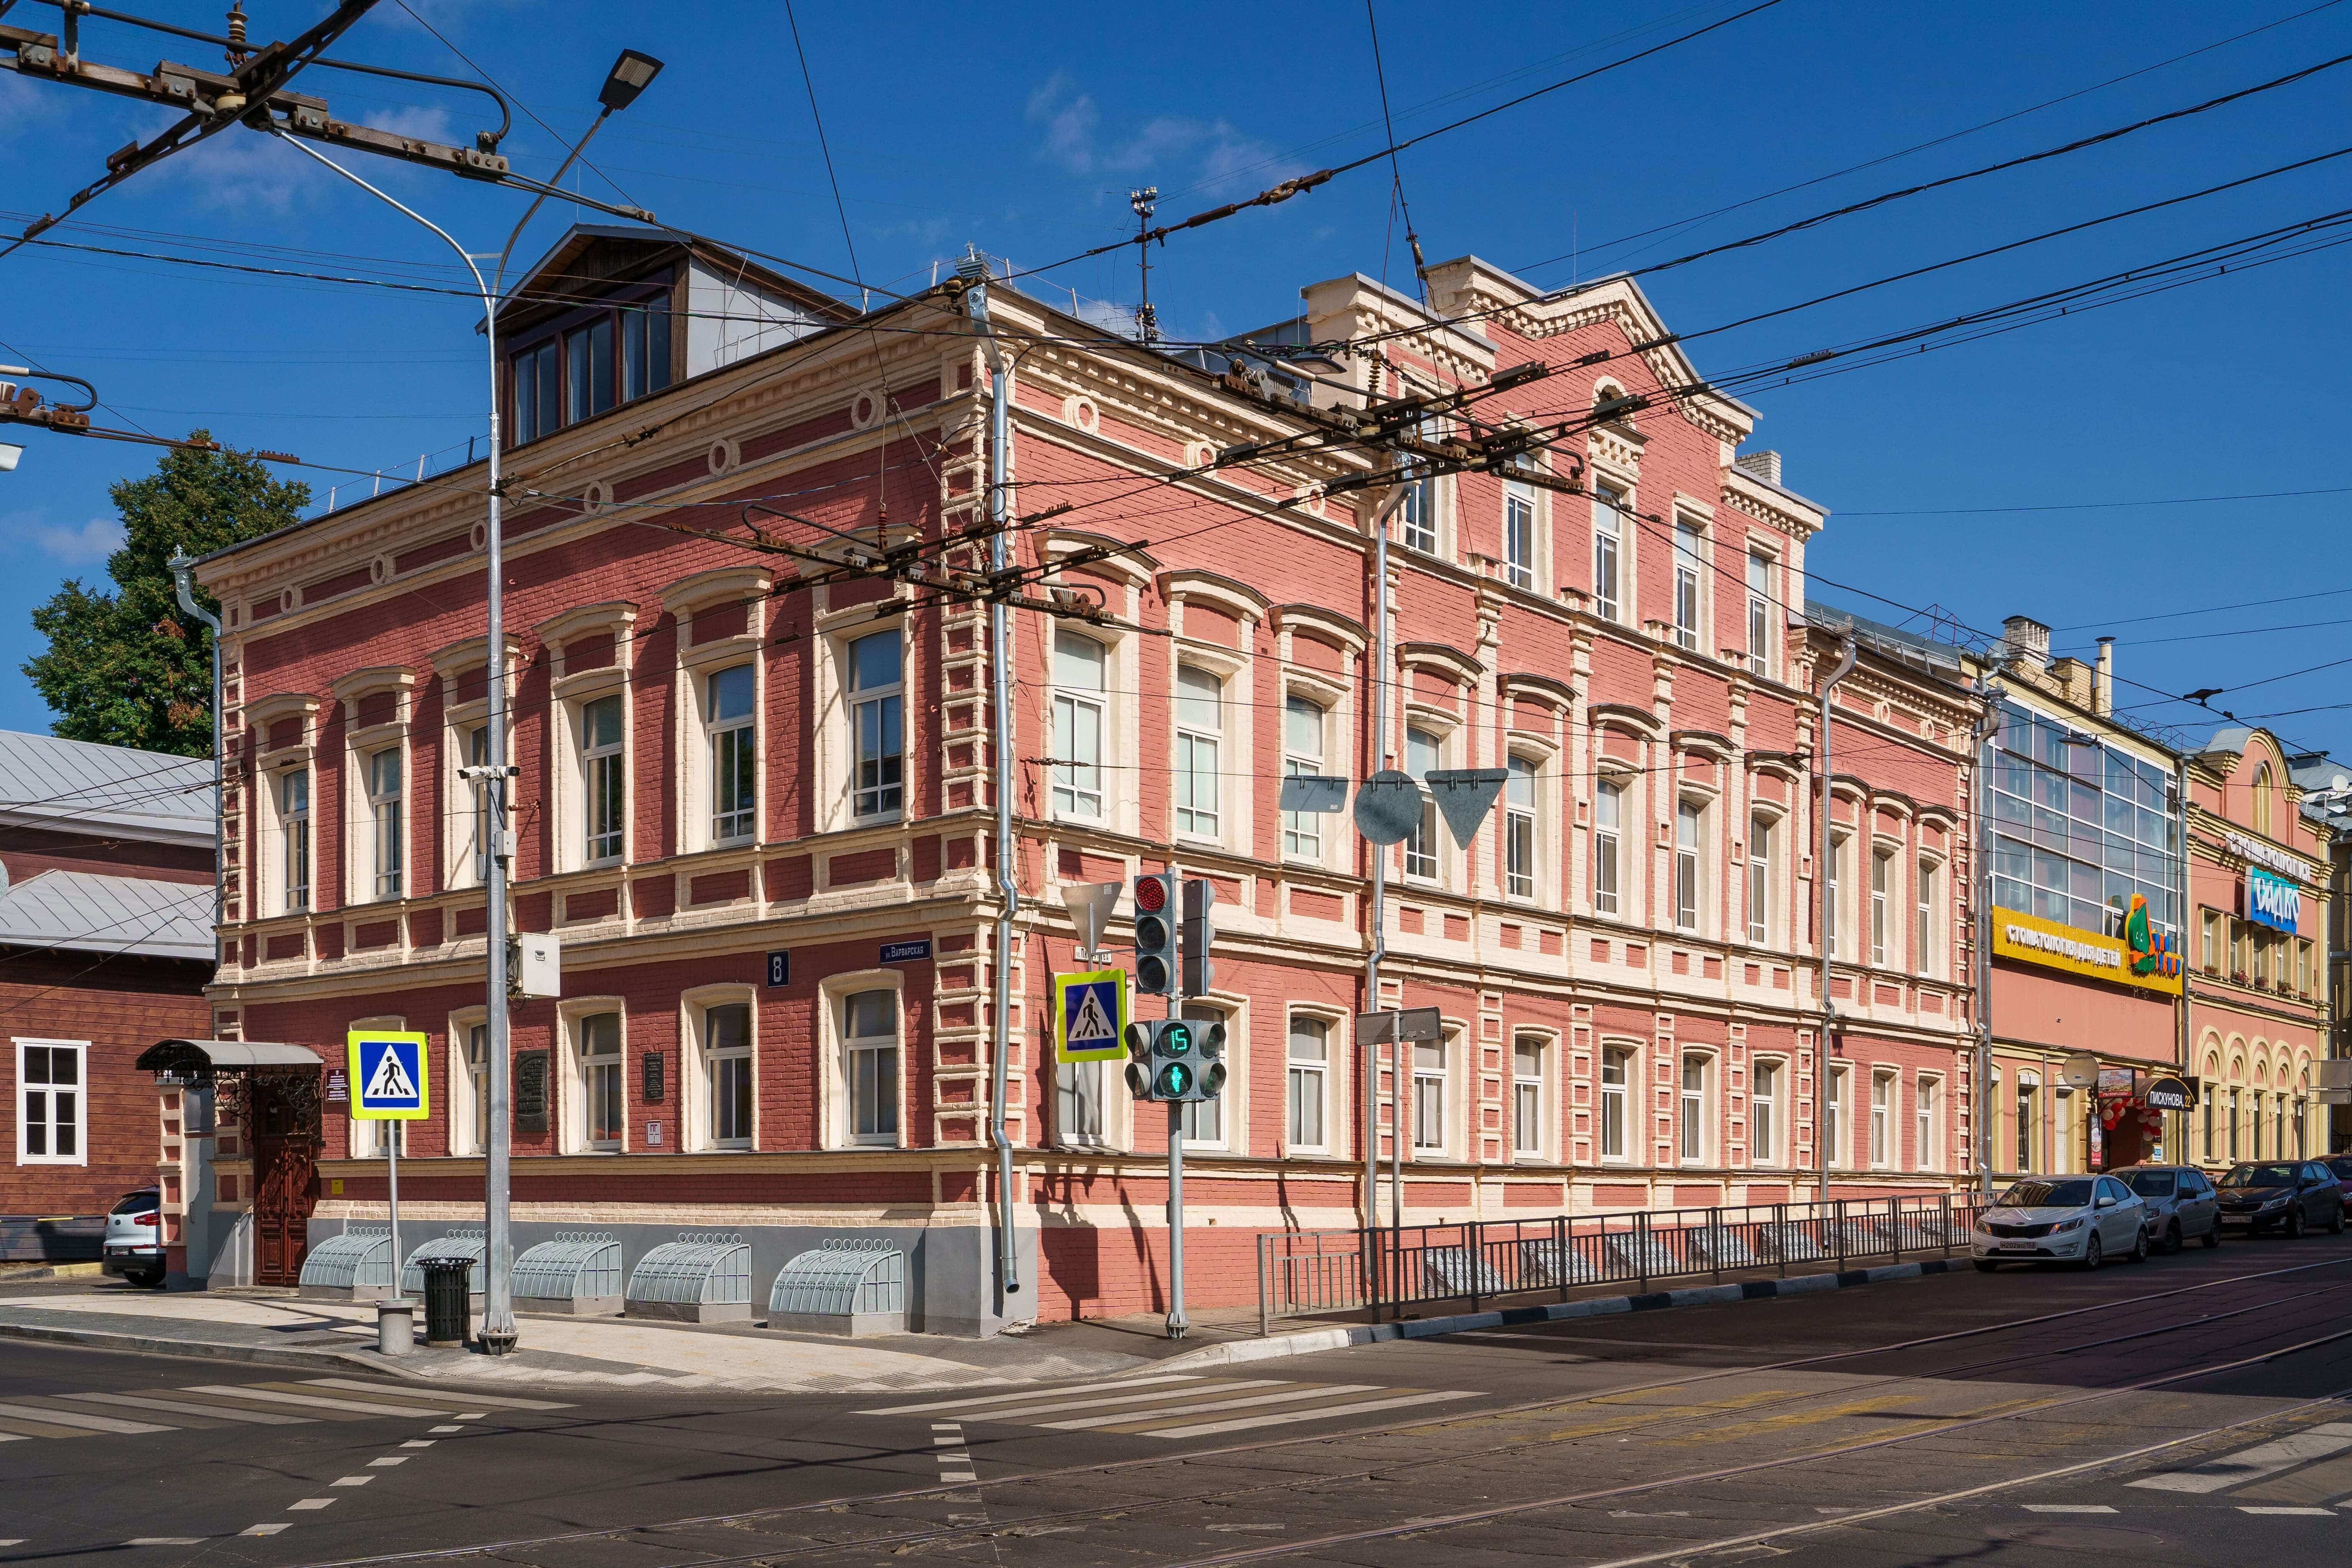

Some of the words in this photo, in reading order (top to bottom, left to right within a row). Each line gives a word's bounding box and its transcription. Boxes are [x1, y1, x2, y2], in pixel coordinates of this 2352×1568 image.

[2226, 832, 2311, 882] СТОМАТОЛОГИЯ
[2253, 877, 2300, 924] САДКО
[2007, 924, 2076, 956] СТОМАТОЛОГИЯ
[2077, 942, 2094, 961] ДЛЯ
[2094, 947, 2121, 967] ДЕТЕЙ
[773, 956, 782, 982] 8
[1171, 1029, 1187, 1050] 15
[2150, 1091, 2184, 1109] ПИСКУНОВА,
[2185, 1095, 2191, 1108] 22
